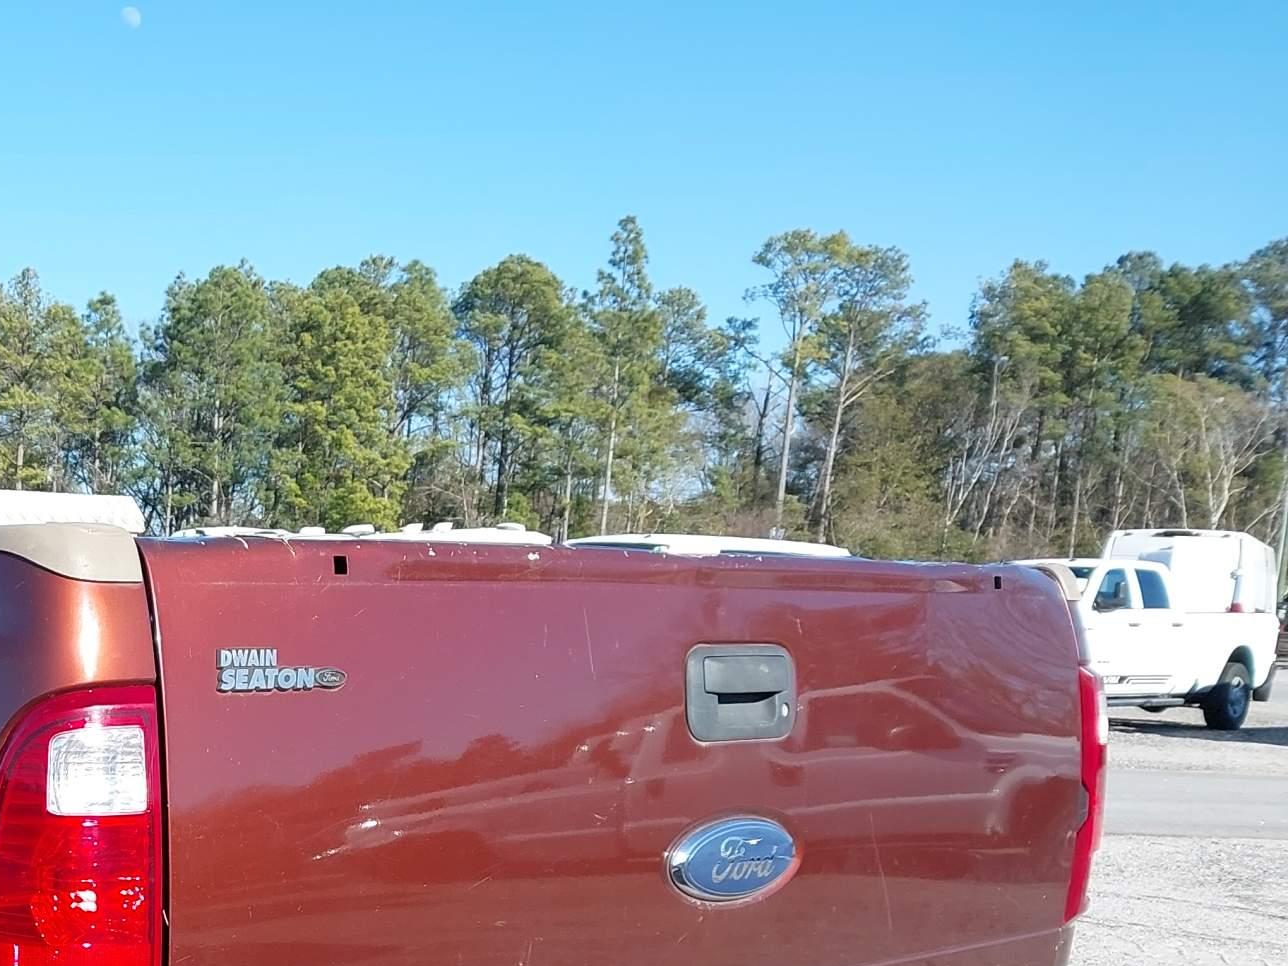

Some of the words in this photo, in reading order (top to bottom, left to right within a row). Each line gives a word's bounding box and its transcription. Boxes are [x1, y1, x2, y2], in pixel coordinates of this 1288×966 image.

[218, 649, 278, 667] DWAIN
[219, 667, 315, 691] SEATON
[712, 836, 780, 884] Ford
